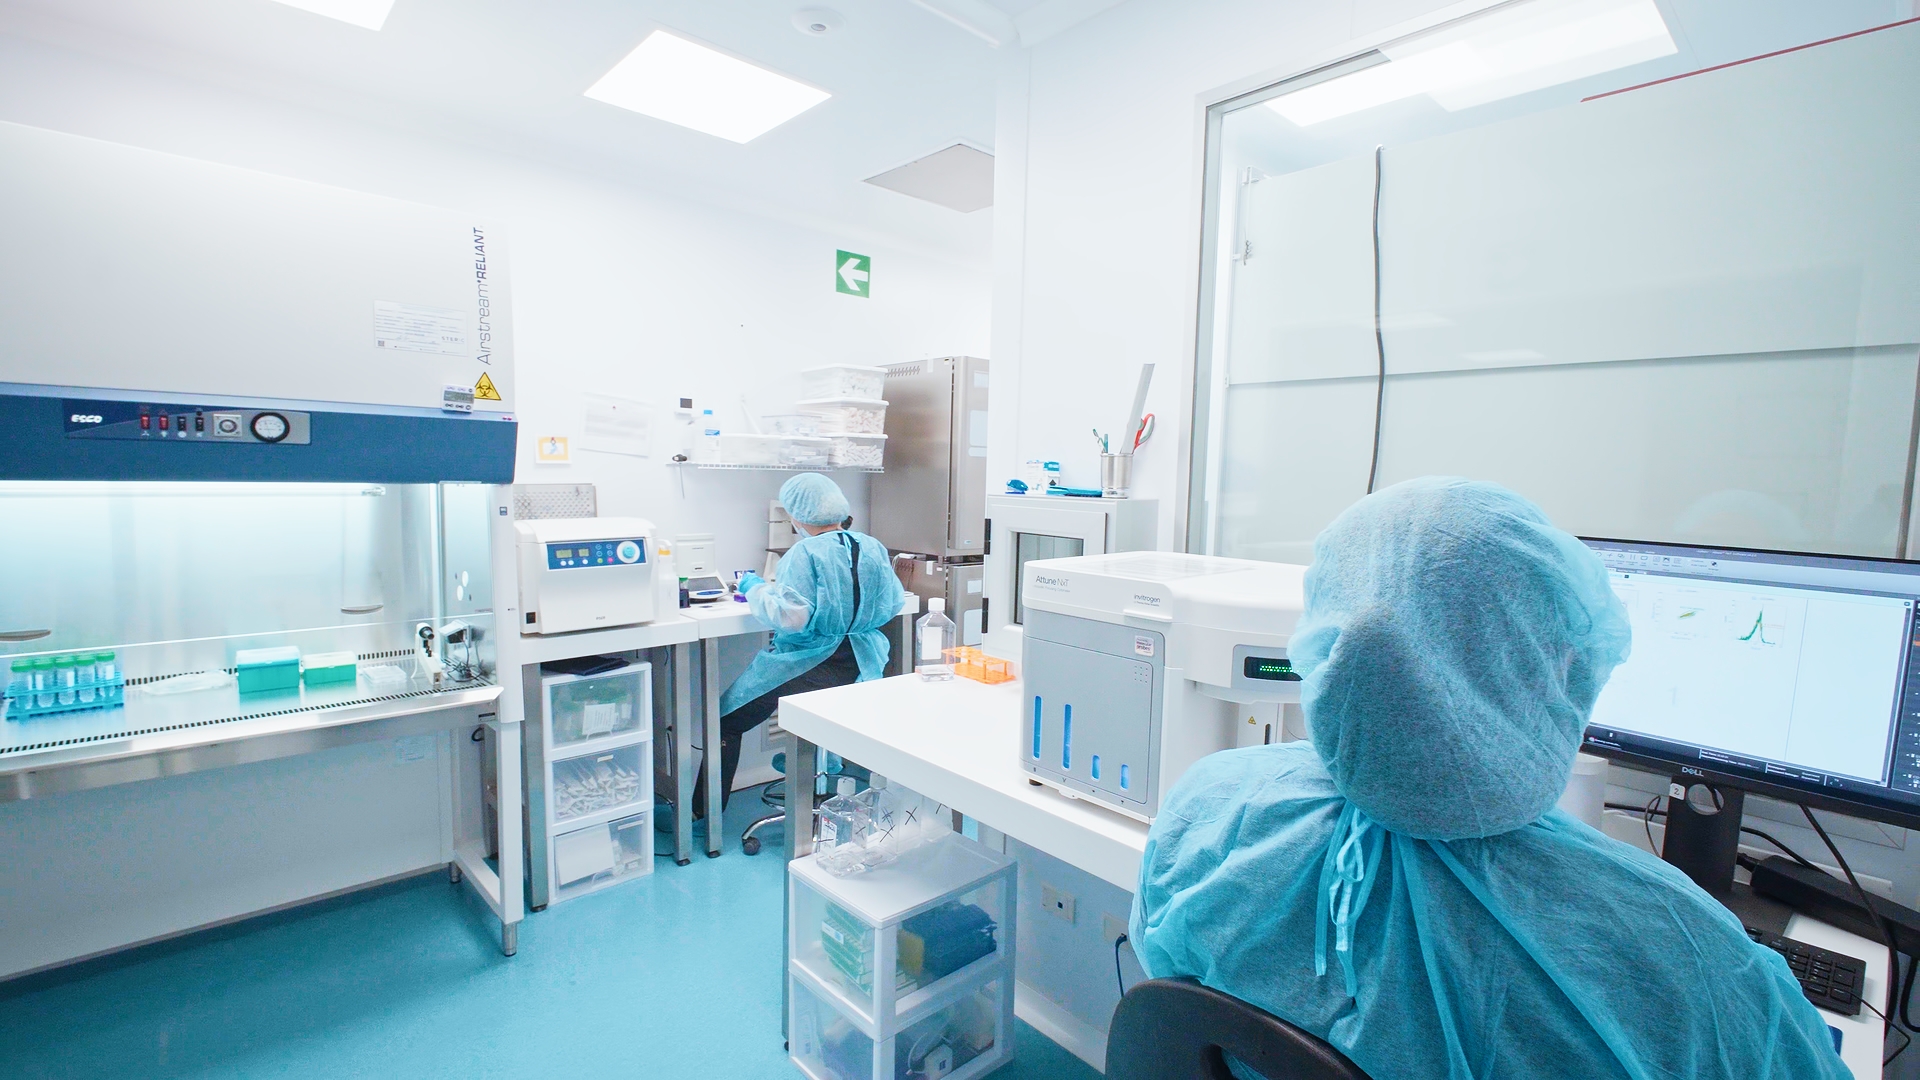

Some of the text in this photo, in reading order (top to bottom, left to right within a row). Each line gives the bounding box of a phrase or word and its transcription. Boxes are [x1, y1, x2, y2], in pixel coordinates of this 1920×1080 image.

[473, 227, 487, 280] RELIANT
[71, 414, 103, 423] ESCO
[1036, 575, 1057, 586] Attune
[1134, 594, 1161, 604] invitrogen
[1681, 766, 1704, 777] DELL
[1674, 787, 1680, 796] 2
